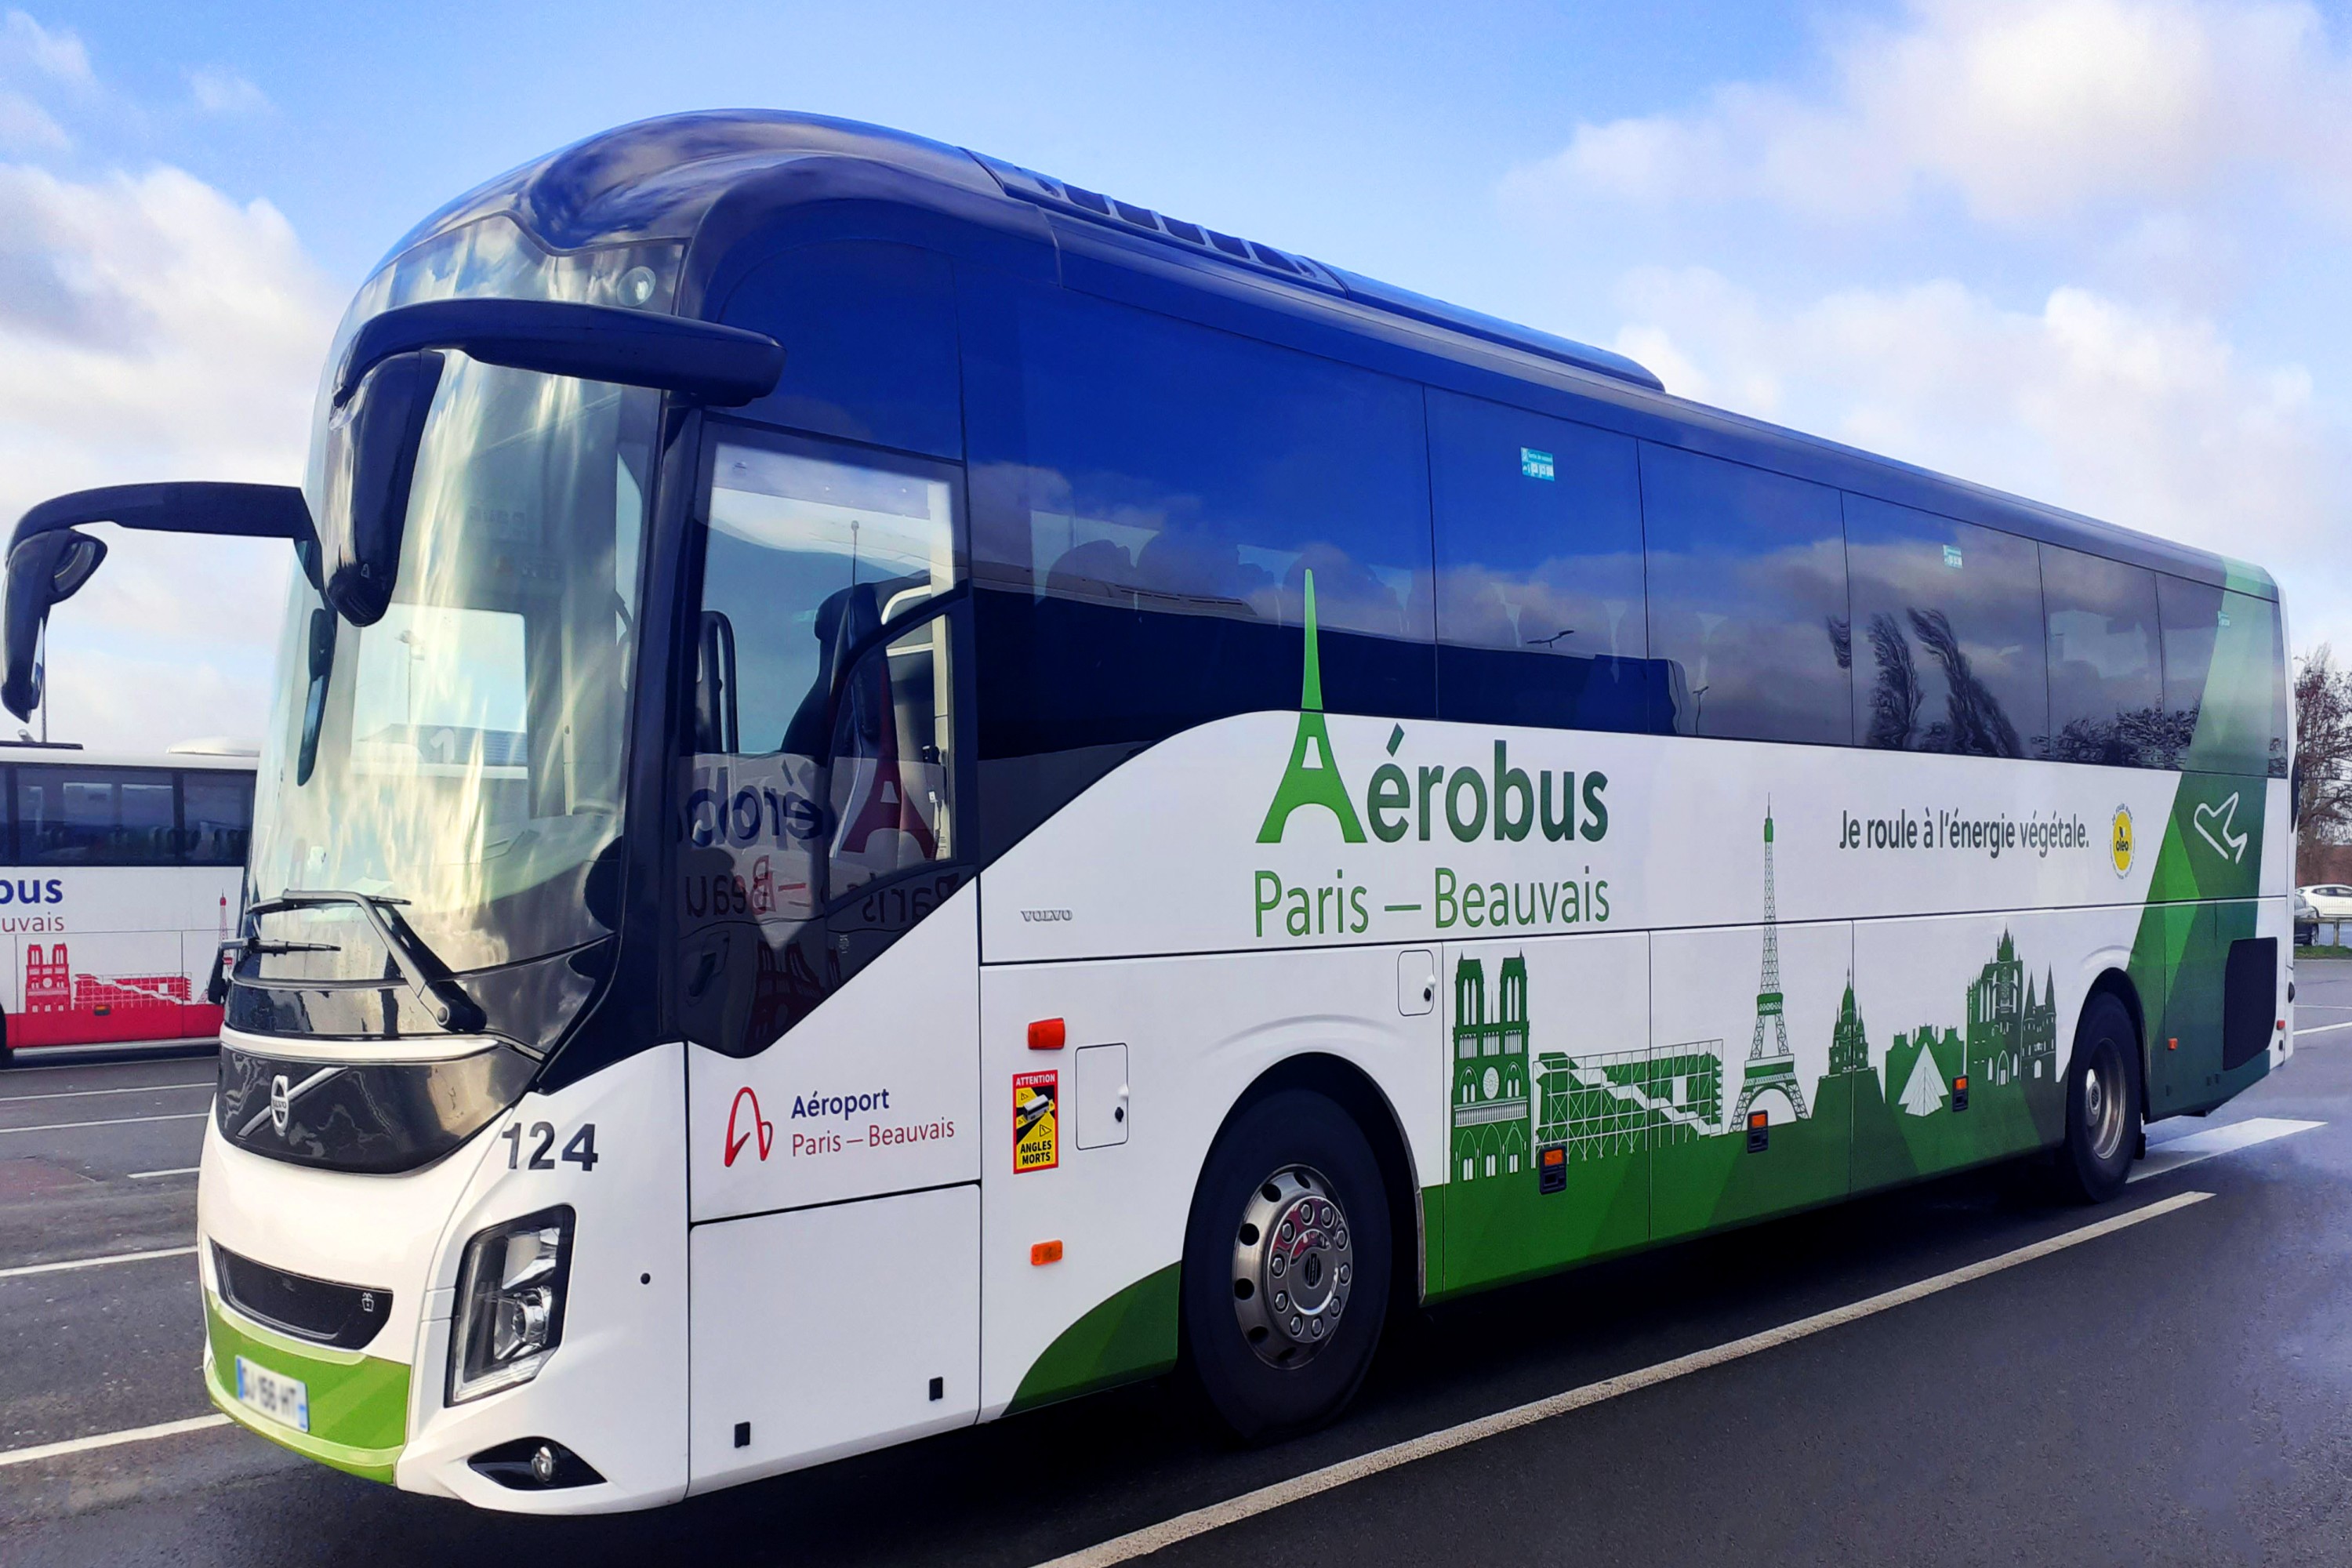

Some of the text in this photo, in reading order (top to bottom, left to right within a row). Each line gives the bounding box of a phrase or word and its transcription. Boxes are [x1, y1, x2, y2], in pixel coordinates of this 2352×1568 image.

[1256, 569, 1608, 843] Aérobus
[1839, 810, 1860, 849] Je
[1867, 808, 1918, 849] roule
[1923, 806, 1933, 848] à
[2020, 810, 2089, 858] végétale.
[1020, 909, 1073, 922] VOLVO
[1255, 869, 1369, 938] Paris
[1435, 865, 1610, 929] Beauvais
[1016, 1074, 1055, 1087] ATTENTION
[791, 1088, 890, 1120] Aéroport
[502, 1121, 598, 1171] 124
[792, 1130, 841, 1156] Paris
[869, 1116, 955, 1147] Beauvais
[1021, 1140, 1052, 1154] ANGLES
[1022, 1152, 1051, 1165] MORTS
